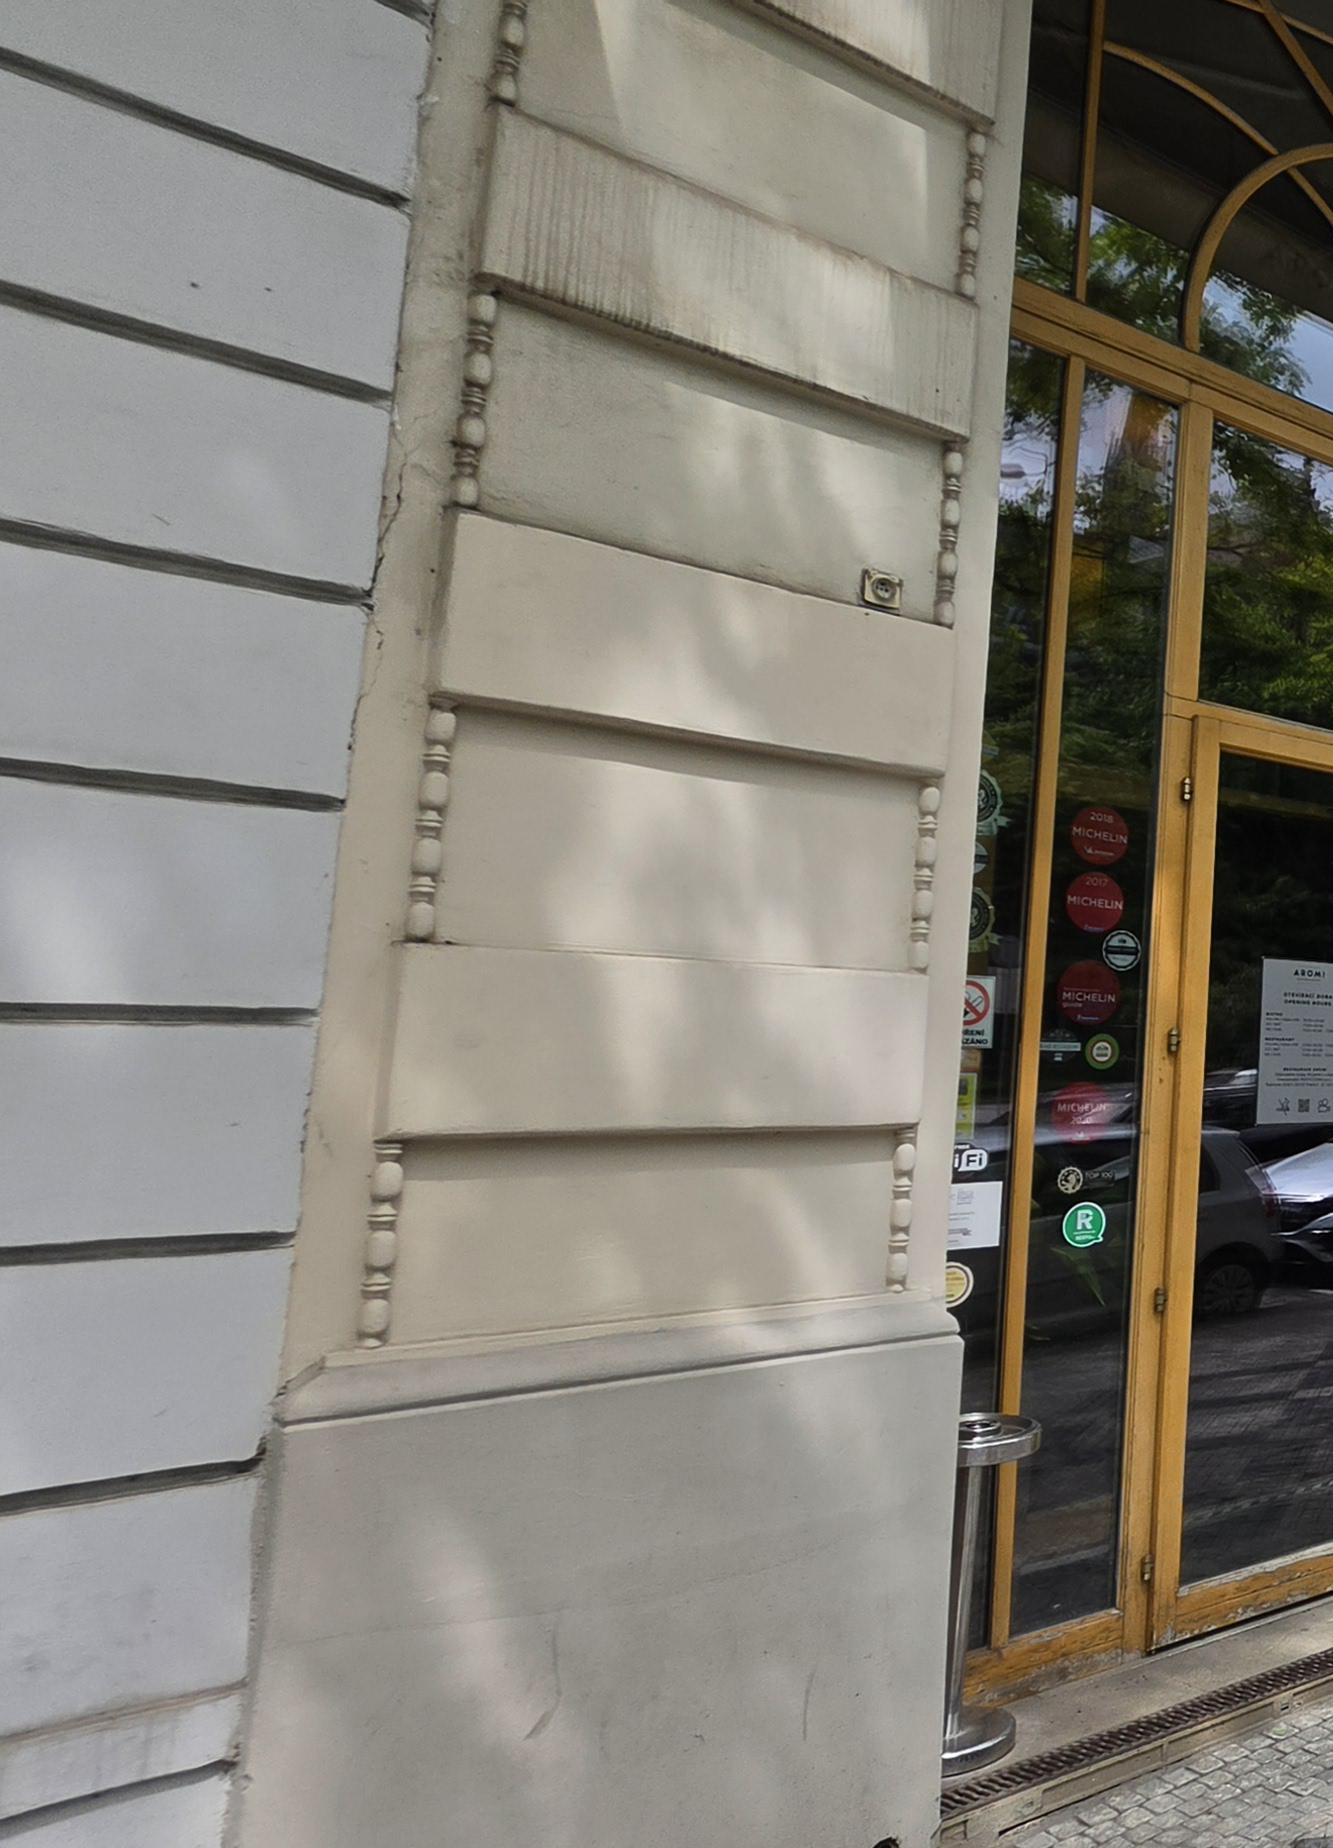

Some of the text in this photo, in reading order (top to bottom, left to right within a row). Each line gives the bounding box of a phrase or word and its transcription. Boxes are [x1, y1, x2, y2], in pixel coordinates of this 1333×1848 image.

[1089, 811, 1115, 824] 2018
[1072, 826, 1128, 844] MICHELIN
[1085, 876, 1109, 887] 2017
[1067, 895, 1124, 910] MICHELIN
[1293, 969, 1326, 978] AROMI
[1062, 991, 1116, 1003] MICHELIN
[1057, 1102, 1107, 1114] MICHELIN
[1076, 1209, 1093, 1230] R
